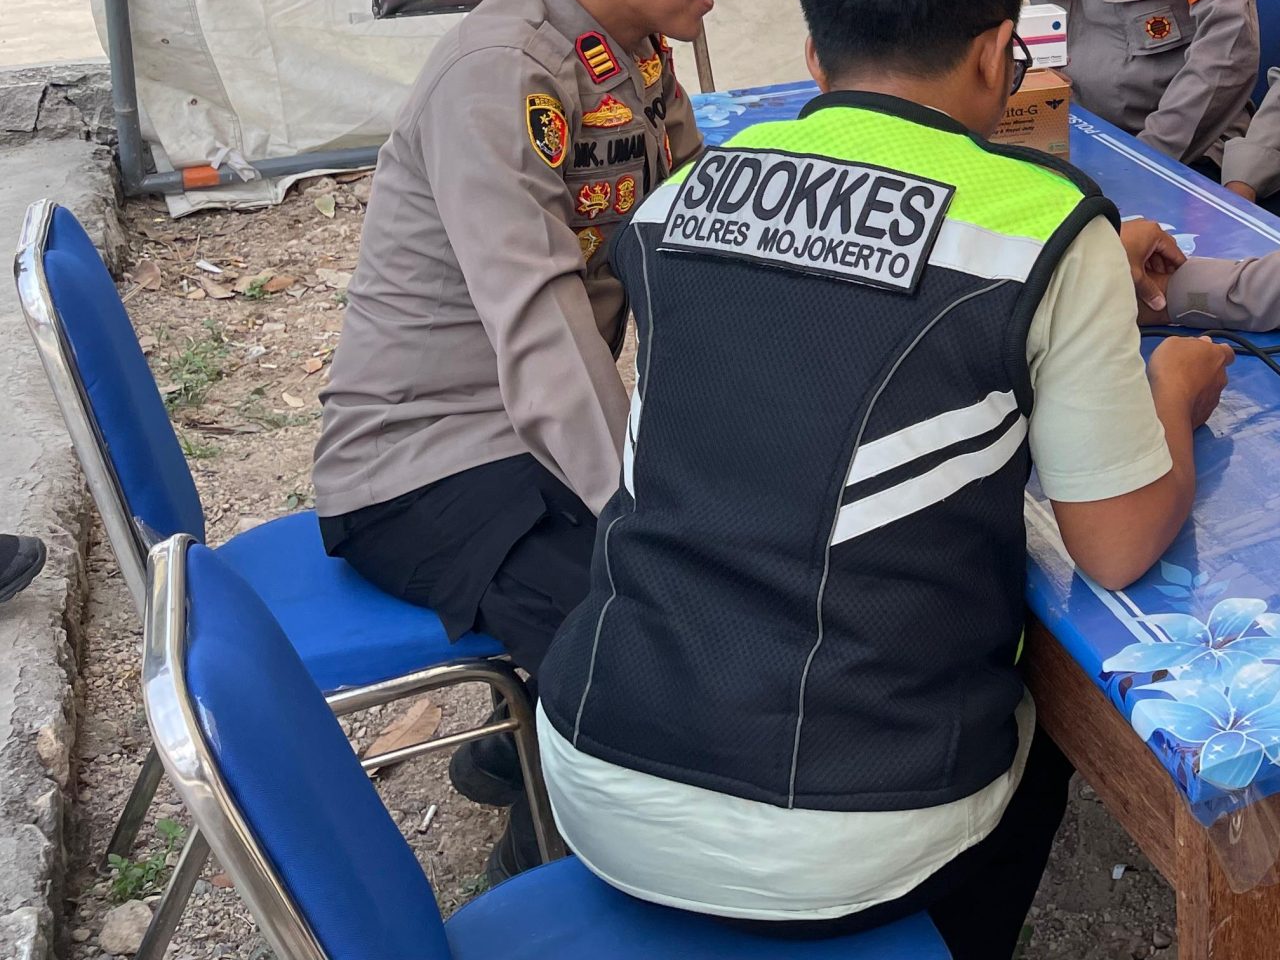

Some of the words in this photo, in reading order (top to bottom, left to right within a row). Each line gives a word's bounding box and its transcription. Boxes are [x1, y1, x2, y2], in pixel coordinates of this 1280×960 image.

[1003, 104, 1038, 118] ita-G
[684, 154, 935, 247] SIDOKKES
[669, 214, 750, 247] POLRES
[757, 227, 910, 279] MOJOKERTO
